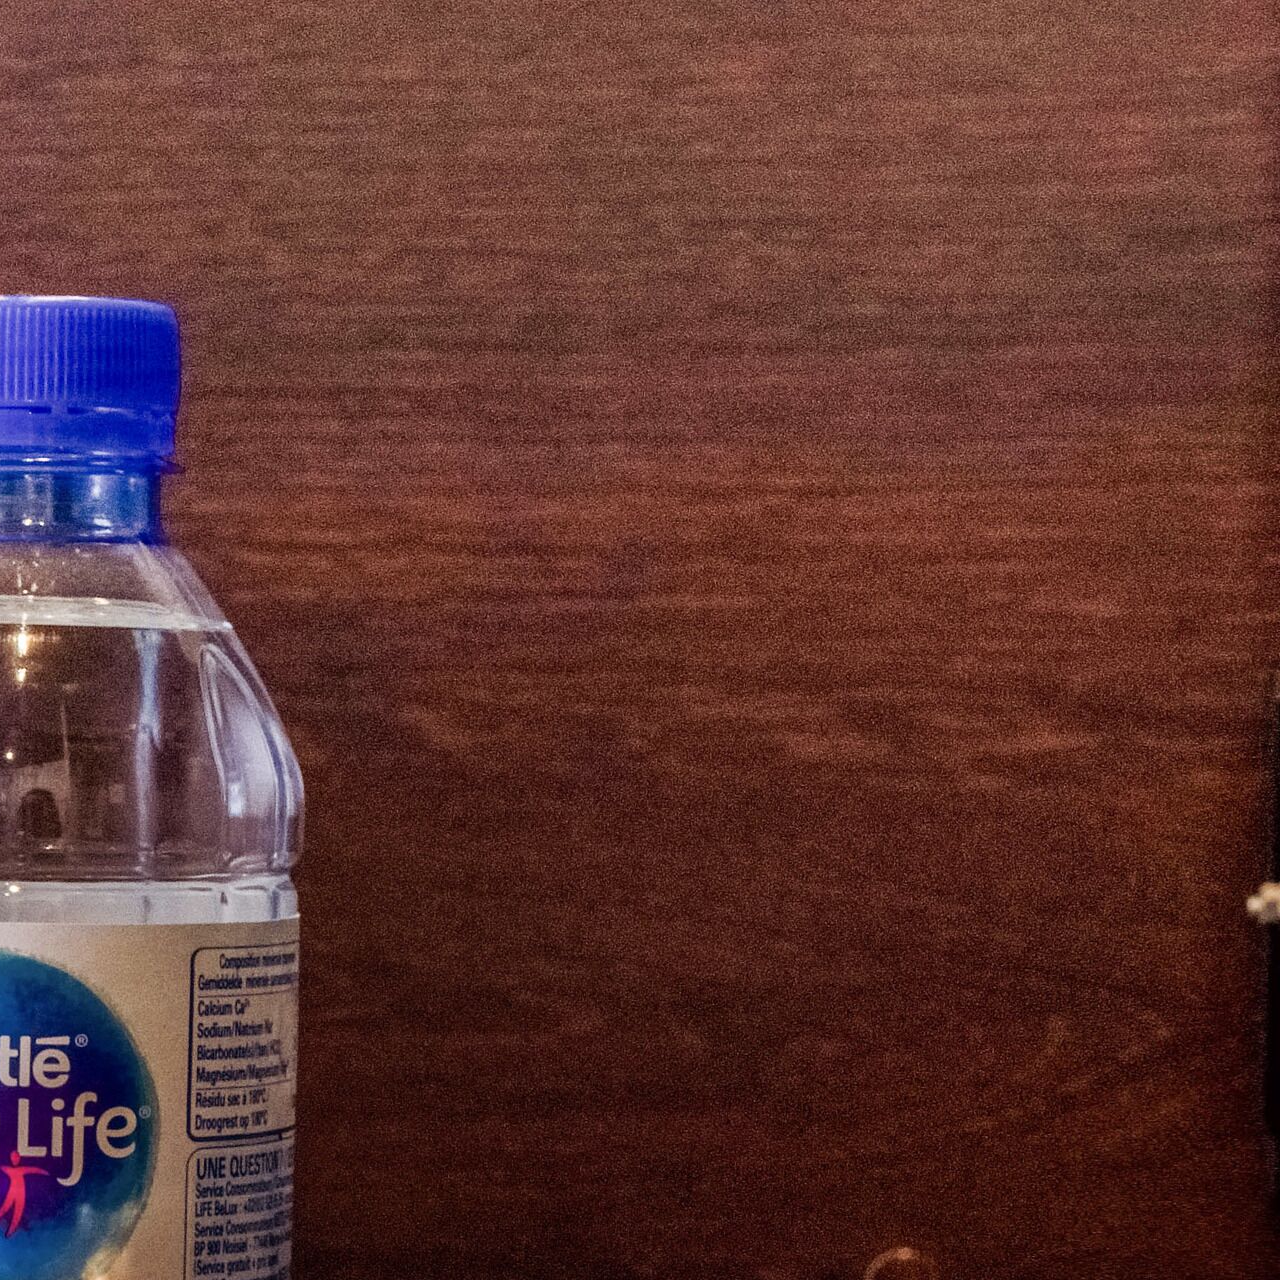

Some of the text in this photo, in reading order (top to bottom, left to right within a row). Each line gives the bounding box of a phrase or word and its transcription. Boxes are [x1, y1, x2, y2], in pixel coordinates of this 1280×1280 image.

[17, 1091, 137, 1187] Life
[197, 1156, 226, 1179] UNE
[230, 1150, 279, 1178] QUESTION
